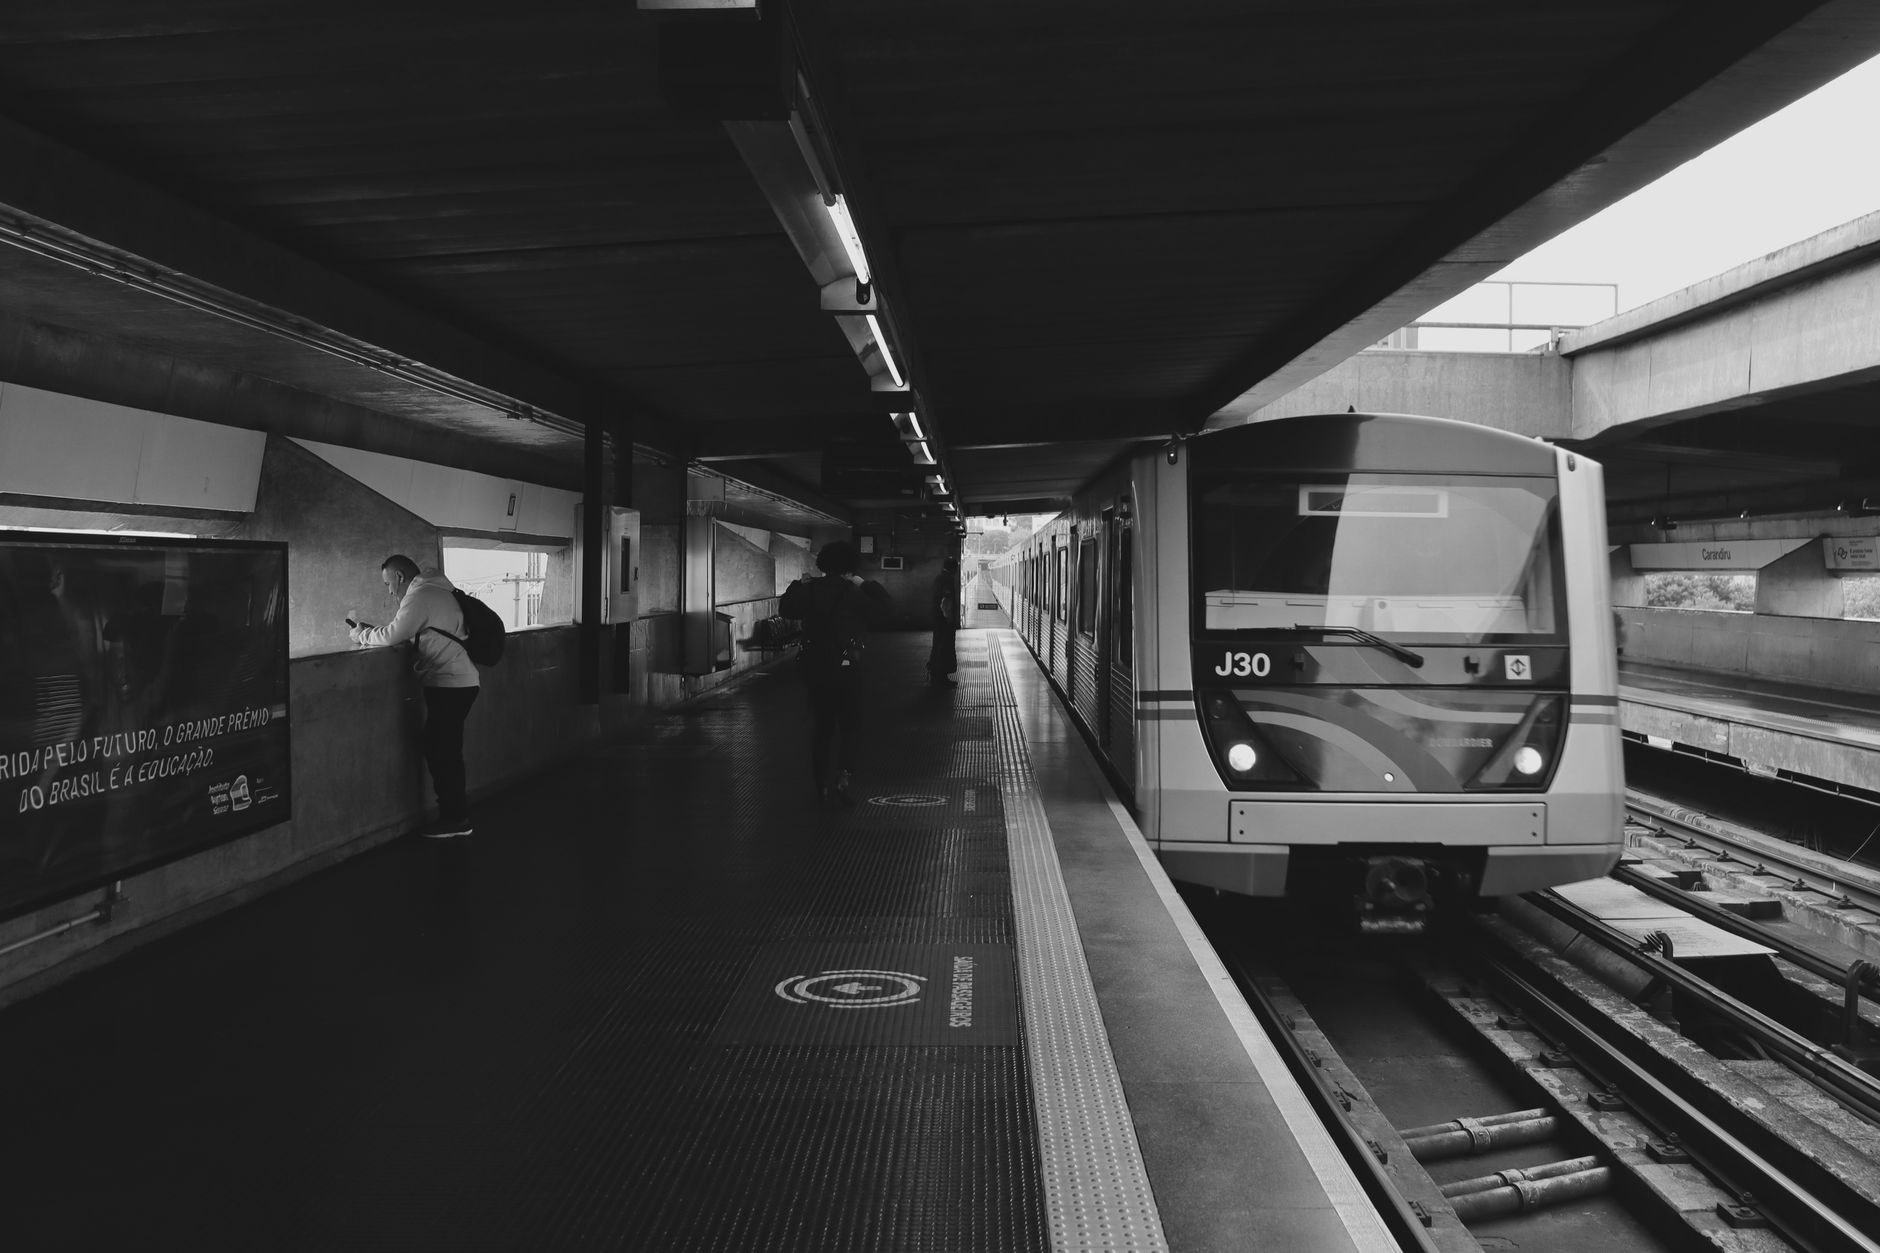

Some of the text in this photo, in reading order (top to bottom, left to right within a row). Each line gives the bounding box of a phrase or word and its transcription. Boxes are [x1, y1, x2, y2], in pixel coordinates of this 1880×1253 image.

[1702, 548, 1732, 561] Carandiru
[1214, 651, 1271, 678] J30
[44, 740, 88, 770] PELO
[93, 729, 158, 754] FUTURO,
[163, 725, 174, 746] O
[176, 715, 226, 744] GRANDE
[227, 706, 269, 733] PRÊMIO
[19, 745, 214, 813] DO BRASIL É A EDUCAÇÃO.
[949, 982, 973, 1028] PASSAGEIROS
